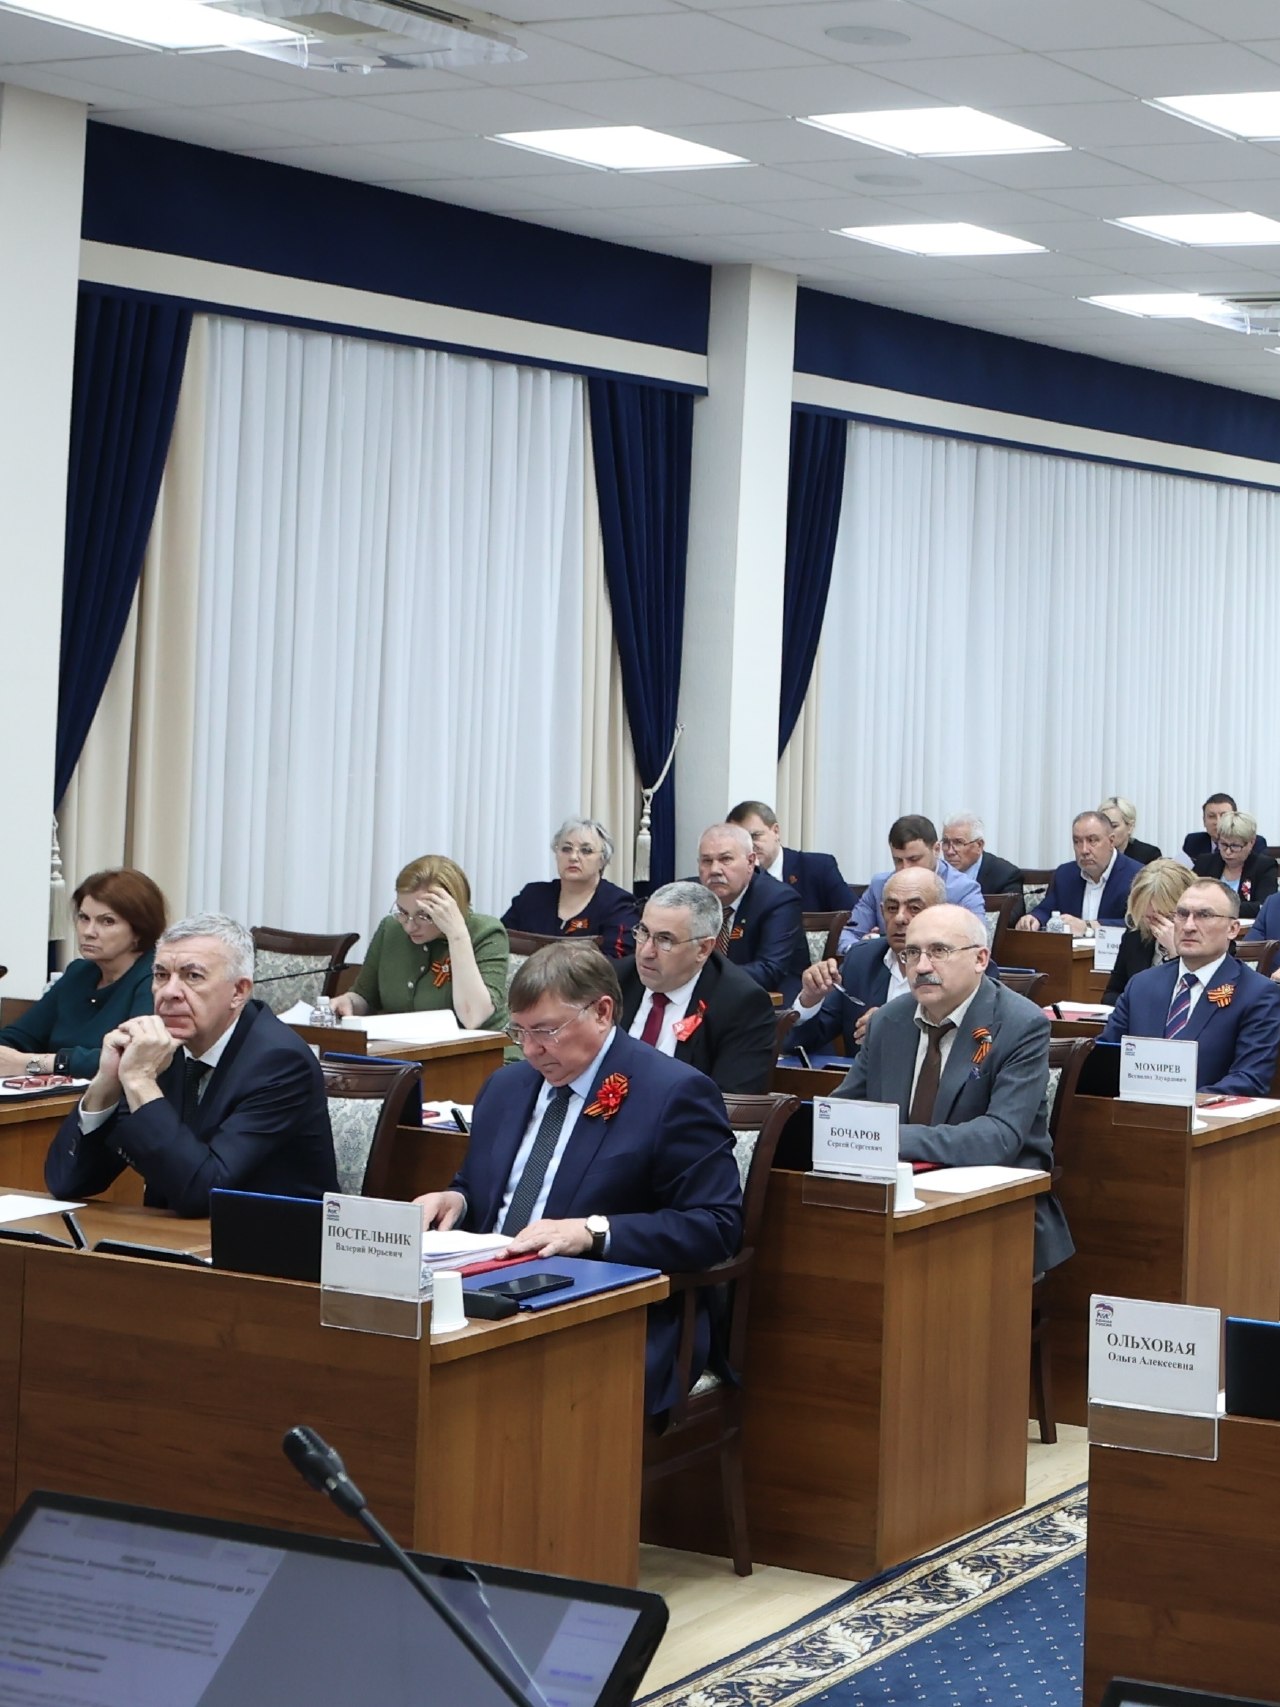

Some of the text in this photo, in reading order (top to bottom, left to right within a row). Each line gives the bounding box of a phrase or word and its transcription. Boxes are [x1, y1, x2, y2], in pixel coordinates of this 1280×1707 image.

[1134, 1061, 1181, 1074] МОХИРЕВ
[830, 1127, 880, 1141] БОЧАРОВ
[827, 1139, 849, 1149] Сергей
[327, 1225, 412, 1246] ПОСТЕЛЬНИК
[335, 1242, 403, 1258] Валерий Юрьевич
[1107, 1333, 1196, 1356] ОЛЬХОВАЯ
[1108, 1351, 1194, 1371] Ольга Алексеевна
